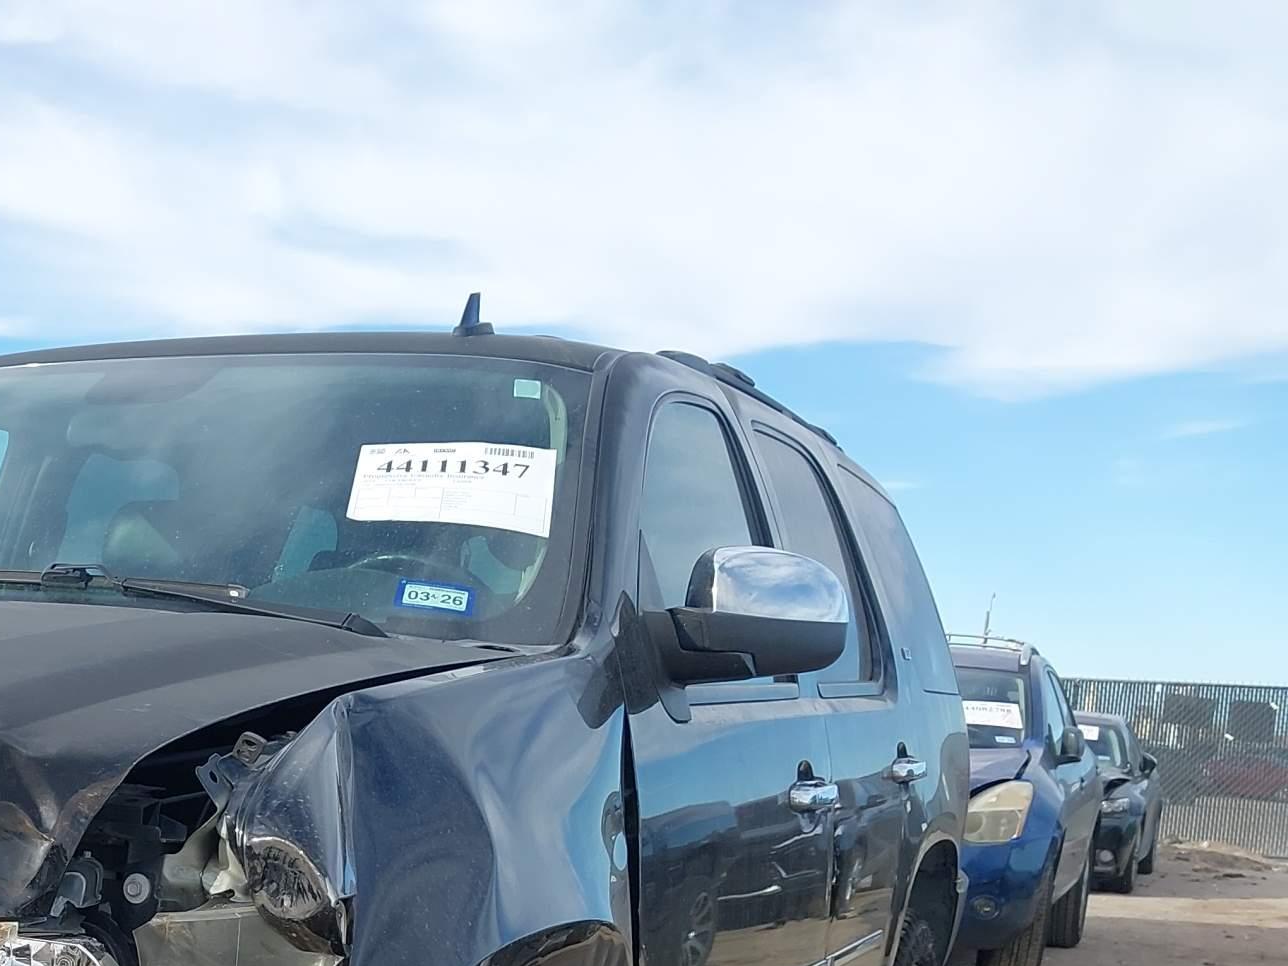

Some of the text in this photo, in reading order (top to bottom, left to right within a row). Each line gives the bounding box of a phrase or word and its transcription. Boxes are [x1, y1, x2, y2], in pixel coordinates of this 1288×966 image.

[376, 458, 530, 479] 44111347
[407, 590, 431, 602] 03
[439, 593, 464, 606] 26
